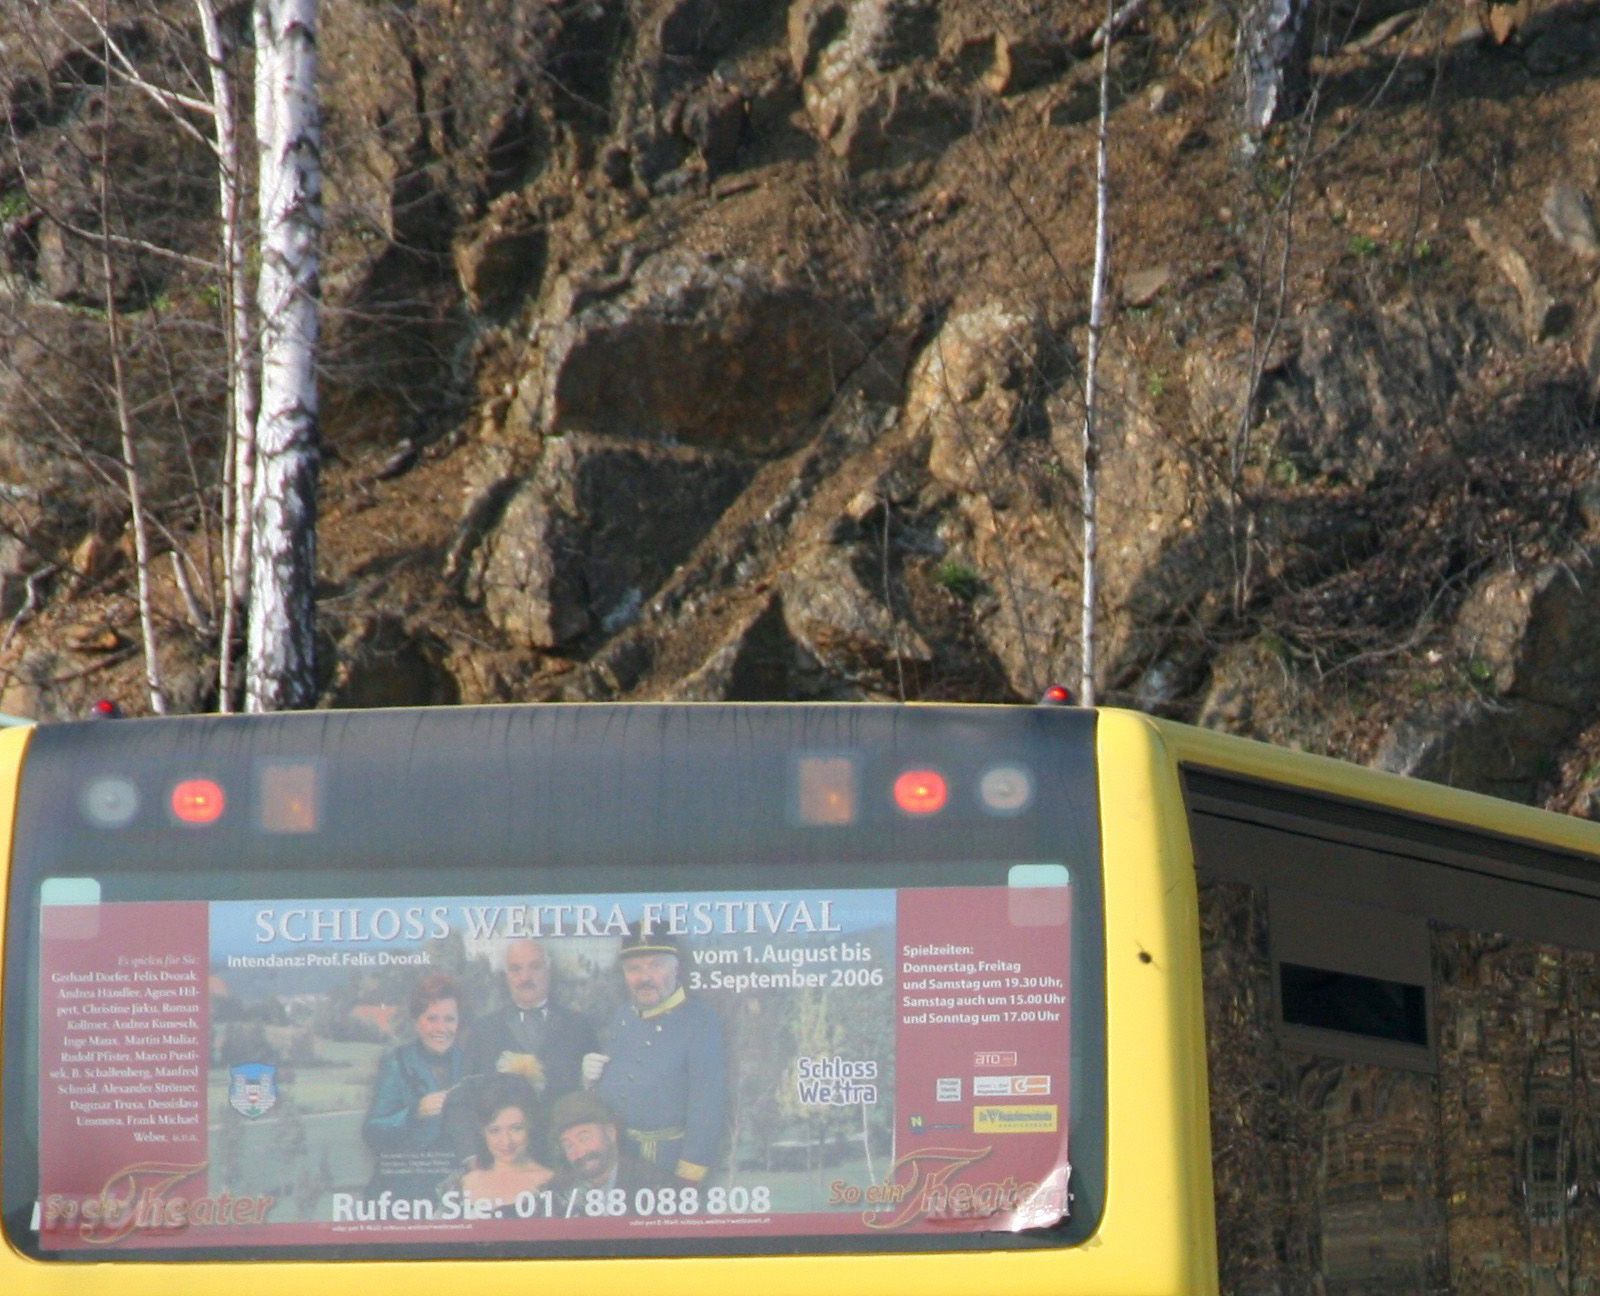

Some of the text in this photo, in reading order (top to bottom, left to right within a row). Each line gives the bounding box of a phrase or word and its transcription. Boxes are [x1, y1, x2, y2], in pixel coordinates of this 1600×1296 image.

[255, 900, 842, 944] SCHLOSS WEITRA FESTIVAL
[227, 951, 431, 968] Intendanz: Prof. Felix Dvorak
[692, 942, 872, 970] vom 1. August bis
[903, 944, 974, 958] Spielzeiten:
[903, 960, 1021, 975] Donnerstag, Freitag
[689, 968, 883, 993] 3. September 2006
[903, 979, 926, 990] und
[928, 978, 980, 991] Samstag
[983, 980, 1001, 988] um
[1005, 978, 1036, 988] 19.30
[903, 993, 1066, 1008] Samstag auch um 15.00 Uhr
[903, 1010, 1060, 1025] und Sonntag um 17.00 Uhr
[797, 1056, 877, 1080] Schloss
[829, 1180, 860, 1204] So
[332, 1190, 434, 1222] Rufen
[441, 1189, 503, 1221] Sie:
[514, 1190, 553, 1218] 01
[585, 1187, 627, 1217] 88
[635, 1186, 699, 1216] 088
[706, 1185, 771, 1215] 808
